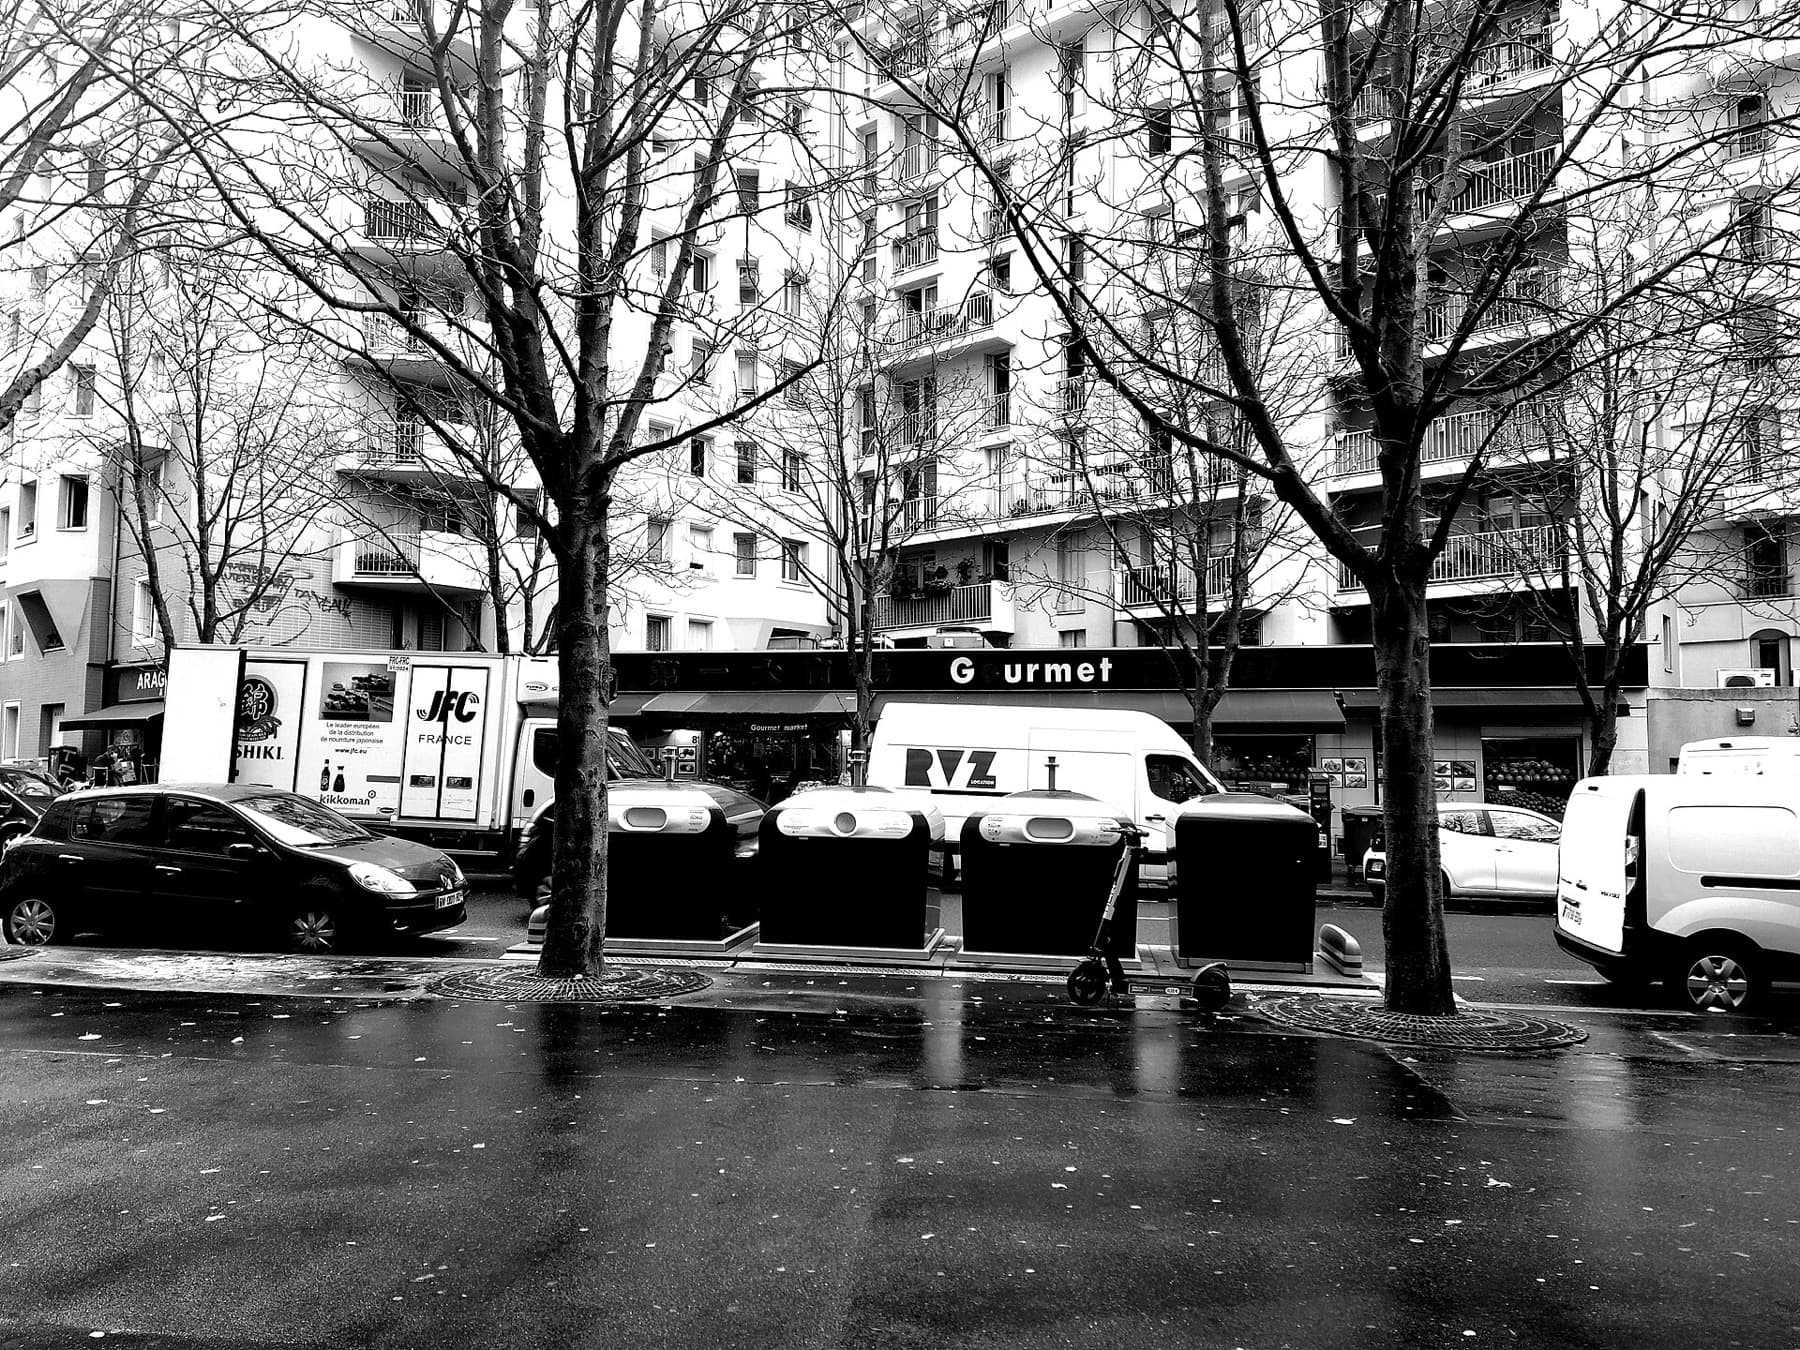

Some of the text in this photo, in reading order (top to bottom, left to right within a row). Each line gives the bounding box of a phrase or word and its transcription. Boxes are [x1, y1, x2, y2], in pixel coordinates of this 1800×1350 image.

[950, 656, 1112, 684] Gurmet
[417, 690, 479, 723] JFC
[783, 723, 808, 731] market
[418, 734, 472, 745] FRANCE
[905, 748, 997, 789] RVZ
[320, 794, 370, 805] kikkoman
